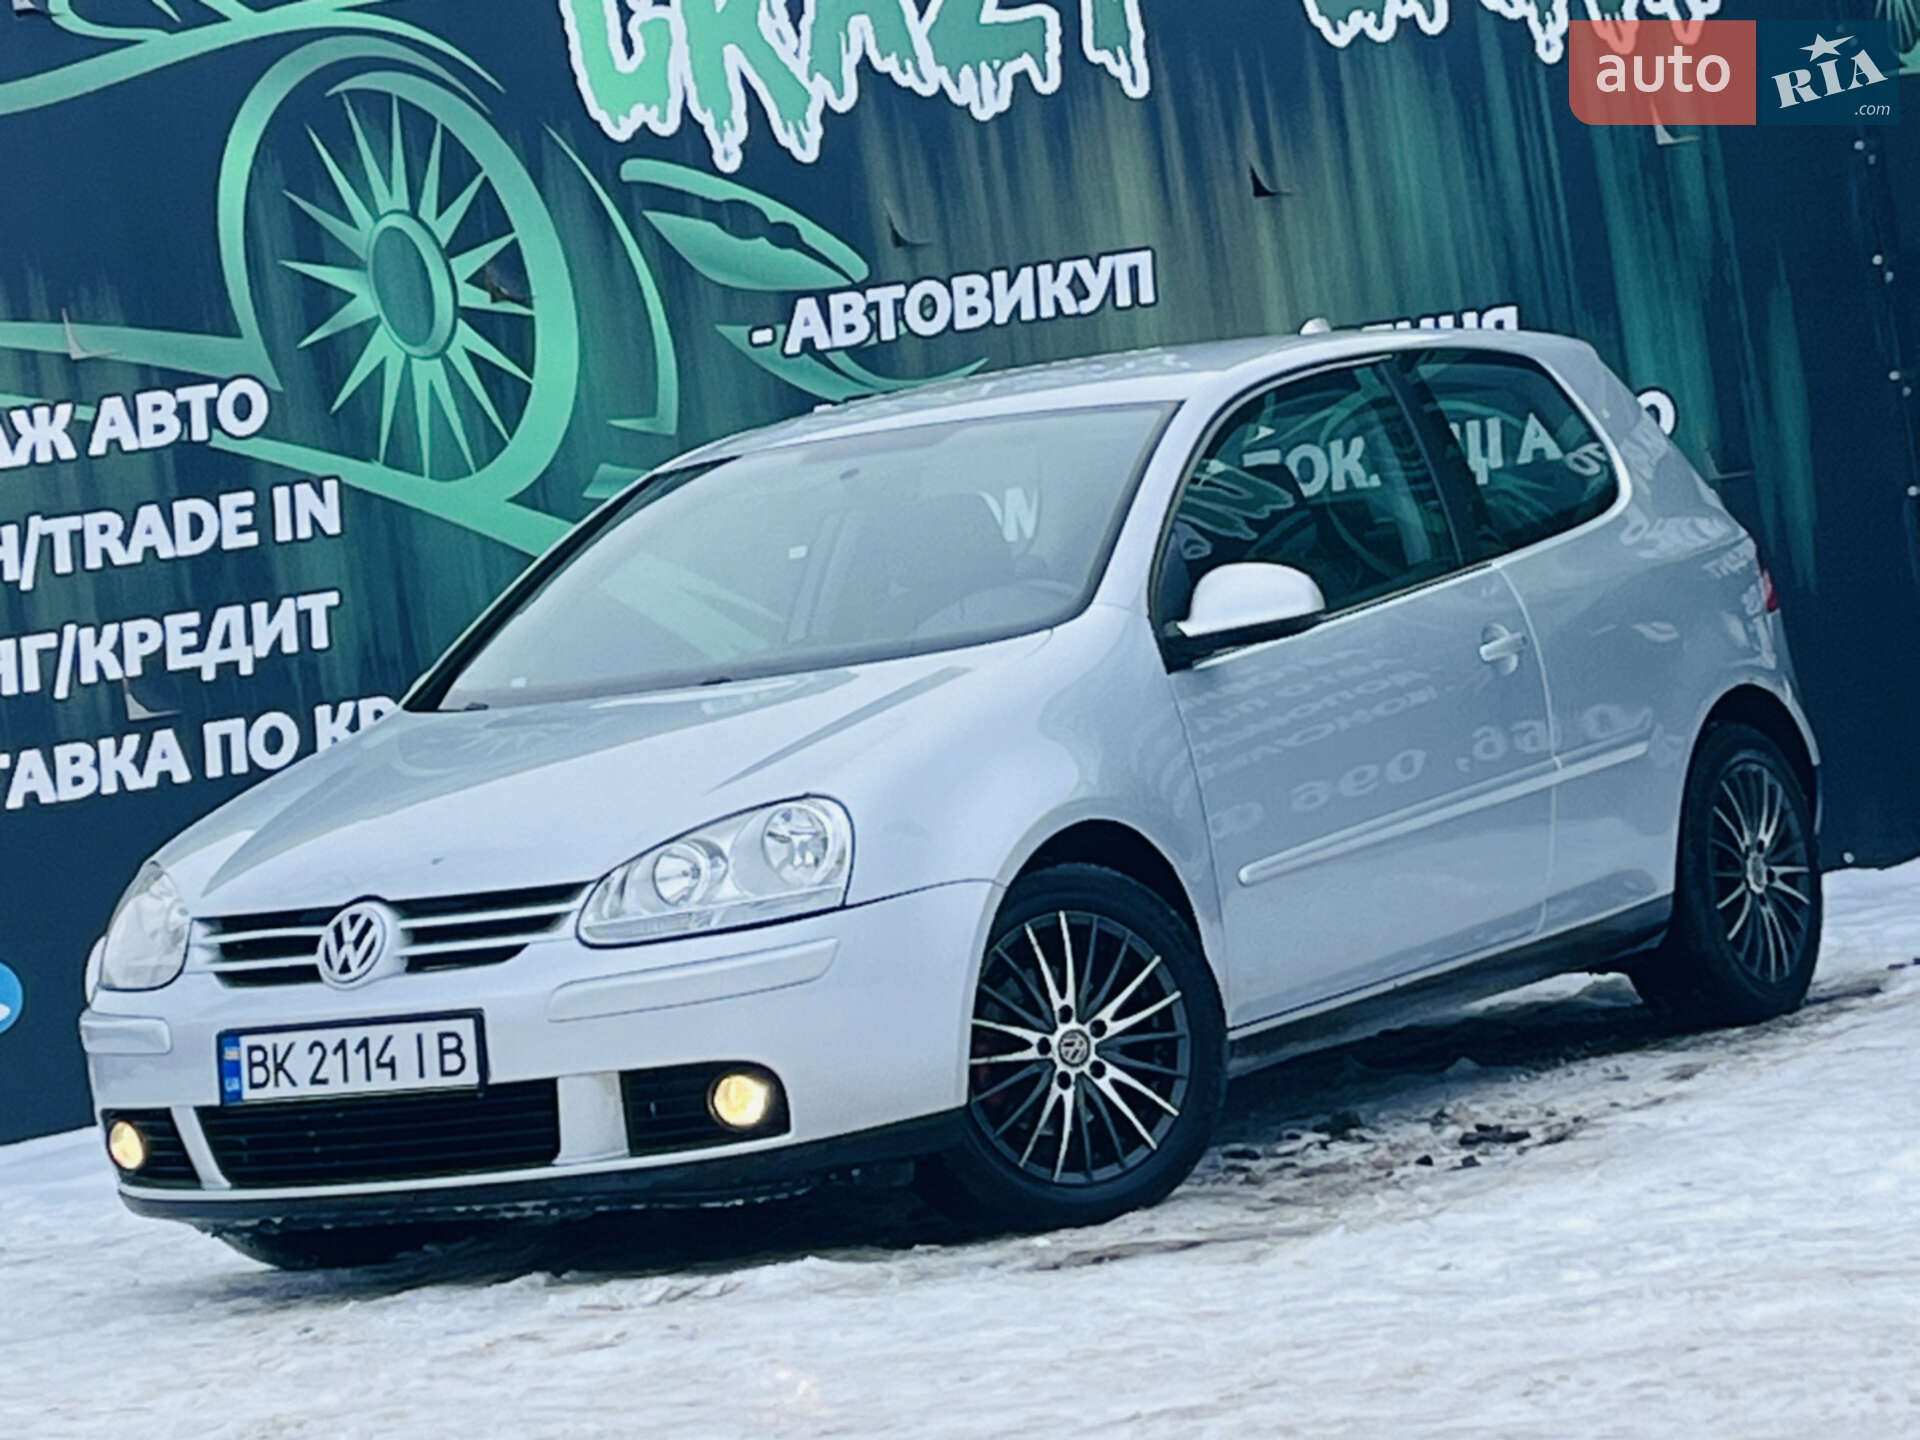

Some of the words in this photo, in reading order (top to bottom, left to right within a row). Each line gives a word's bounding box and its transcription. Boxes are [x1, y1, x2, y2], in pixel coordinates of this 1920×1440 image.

[783, 249, 1155, 356] АВТОВИКУП
[88, 375, 270, 457] АВТО
[272, 478, 342, 543] IN
[0, 728, 192, 810] АВКА
[203, 711, 300, 779] ПО
[246, 1041, 298, 1091] BK
[307, 1034, 398, 1087] 2114
